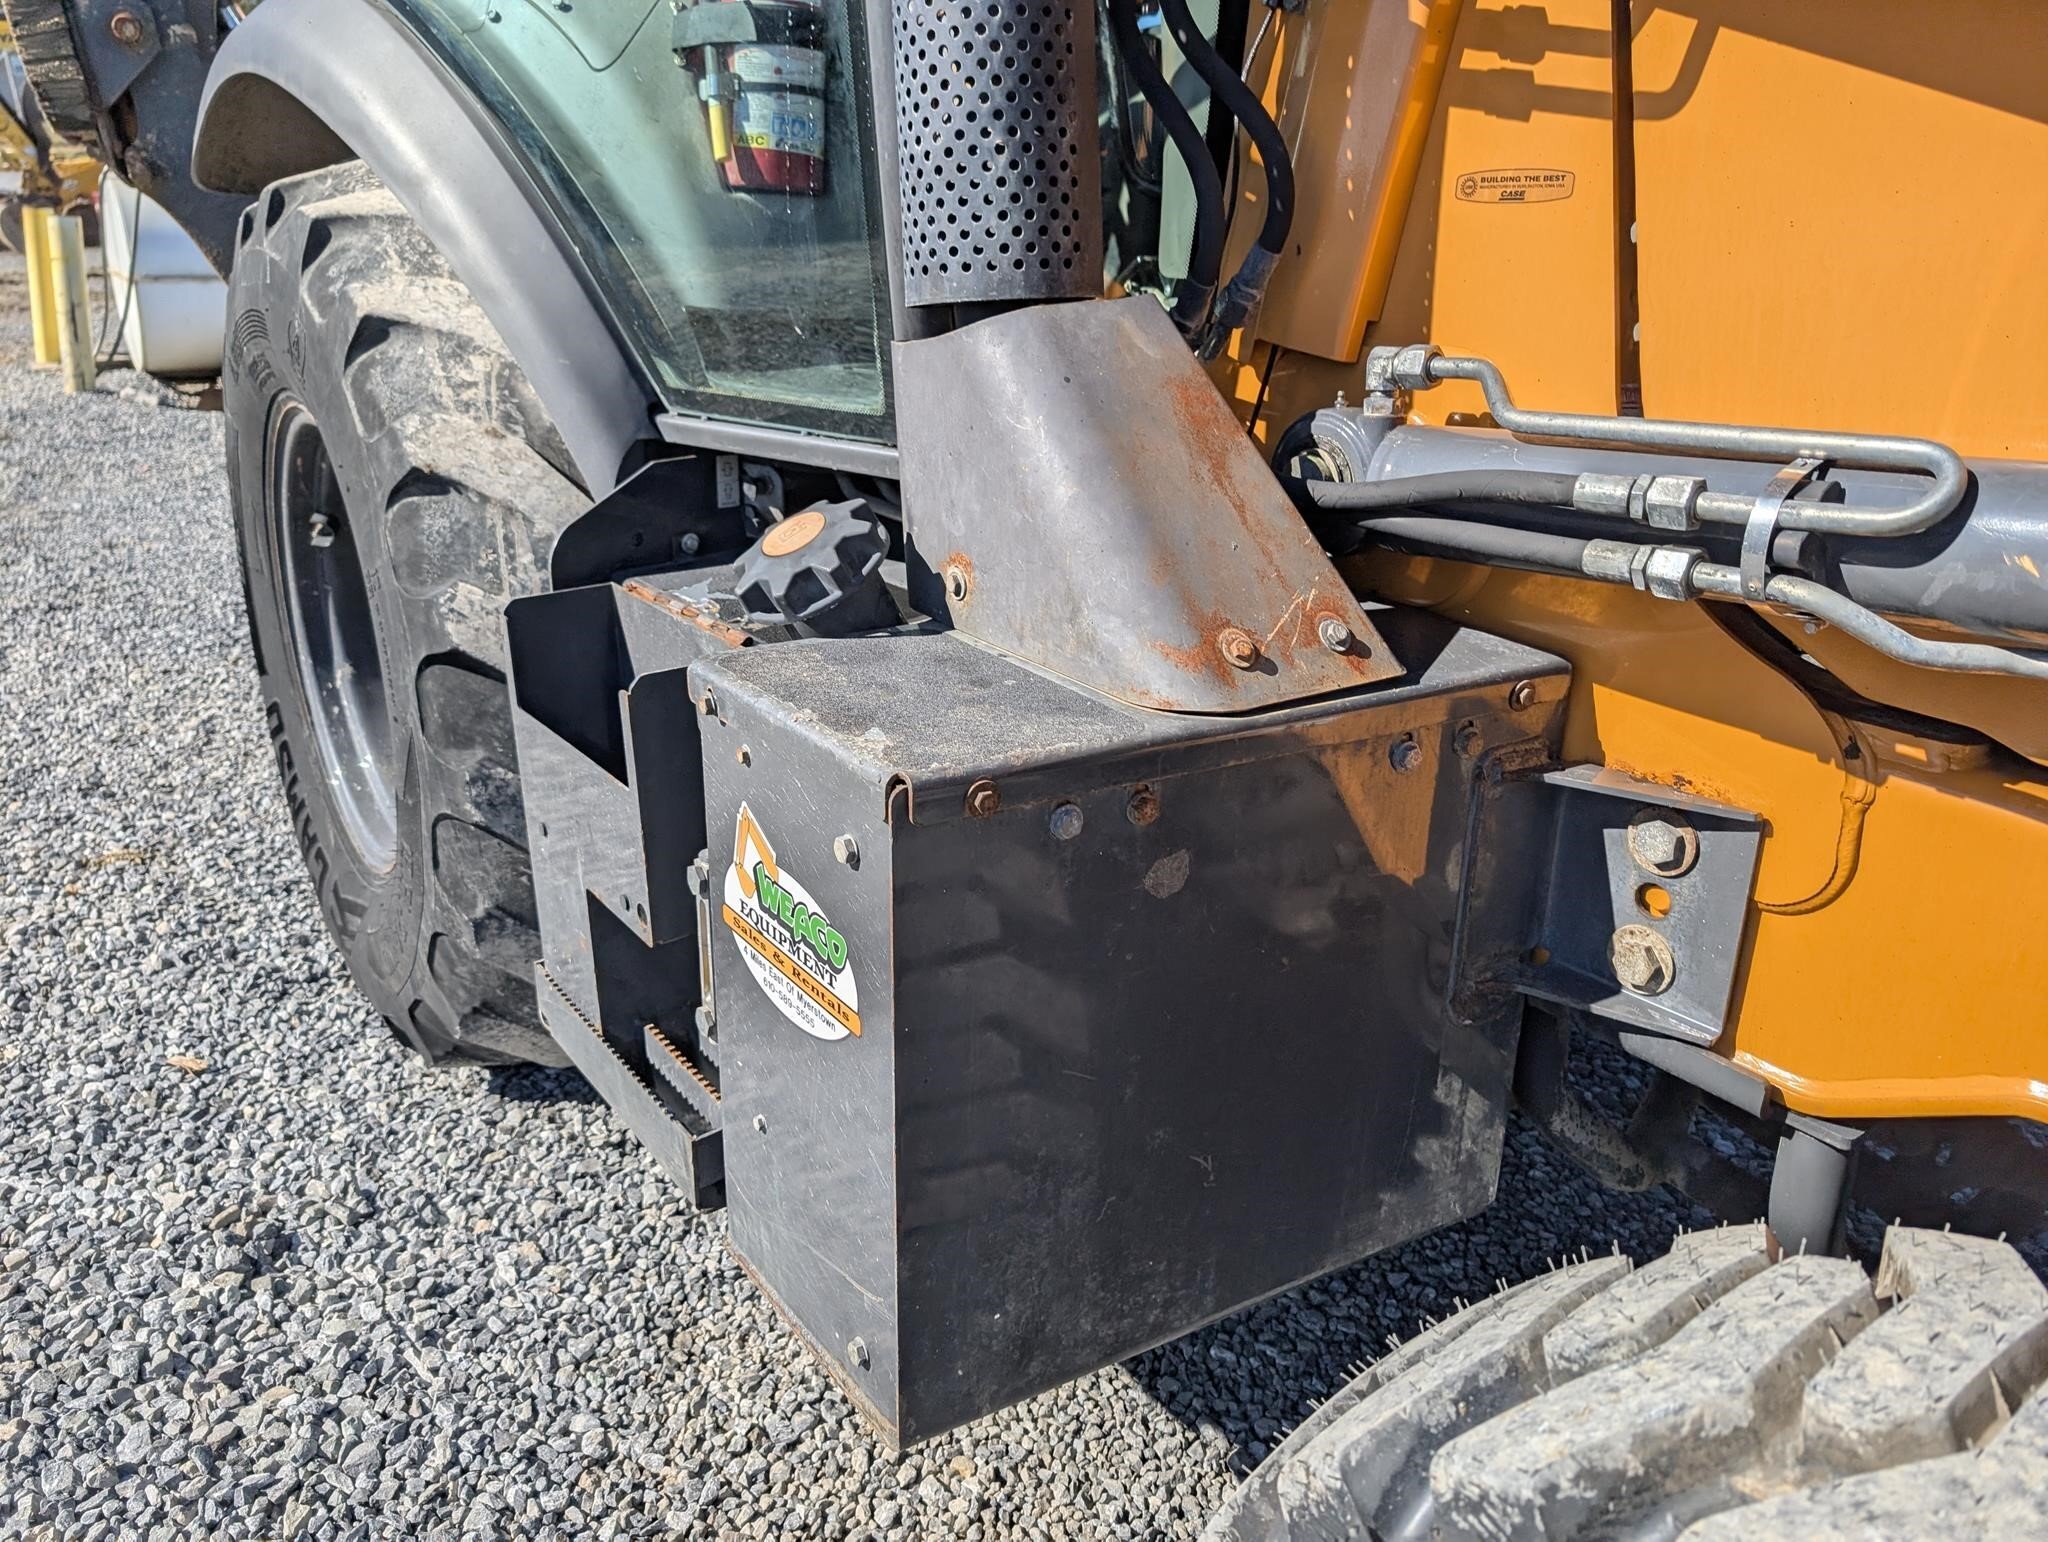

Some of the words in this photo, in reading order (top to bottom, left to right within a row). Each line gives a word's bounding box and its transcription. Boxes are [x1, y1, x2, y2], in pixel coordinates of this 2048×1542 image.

[737, 135, 765, 145] ABC
[1480, 175, 1521, 183] BUILDING
[1543, 174, 1567, 182] BEST
[1500, 190, 1526, 198] CASE
[740, 898, 837, 989] EQUIPMENT
[754, 862, 848, 971] WEACO
[733, 916, 767, 951] Sales
[772, 951, 786, 967] &
[792, 967, 850, 1022] Rentals
[763, 976, 816, 1028] 610-589-5555
[769, 966, 784, 987] East
[786, 982, 794, 995] Of
[797, 990, 836, 1032] Myerstown
